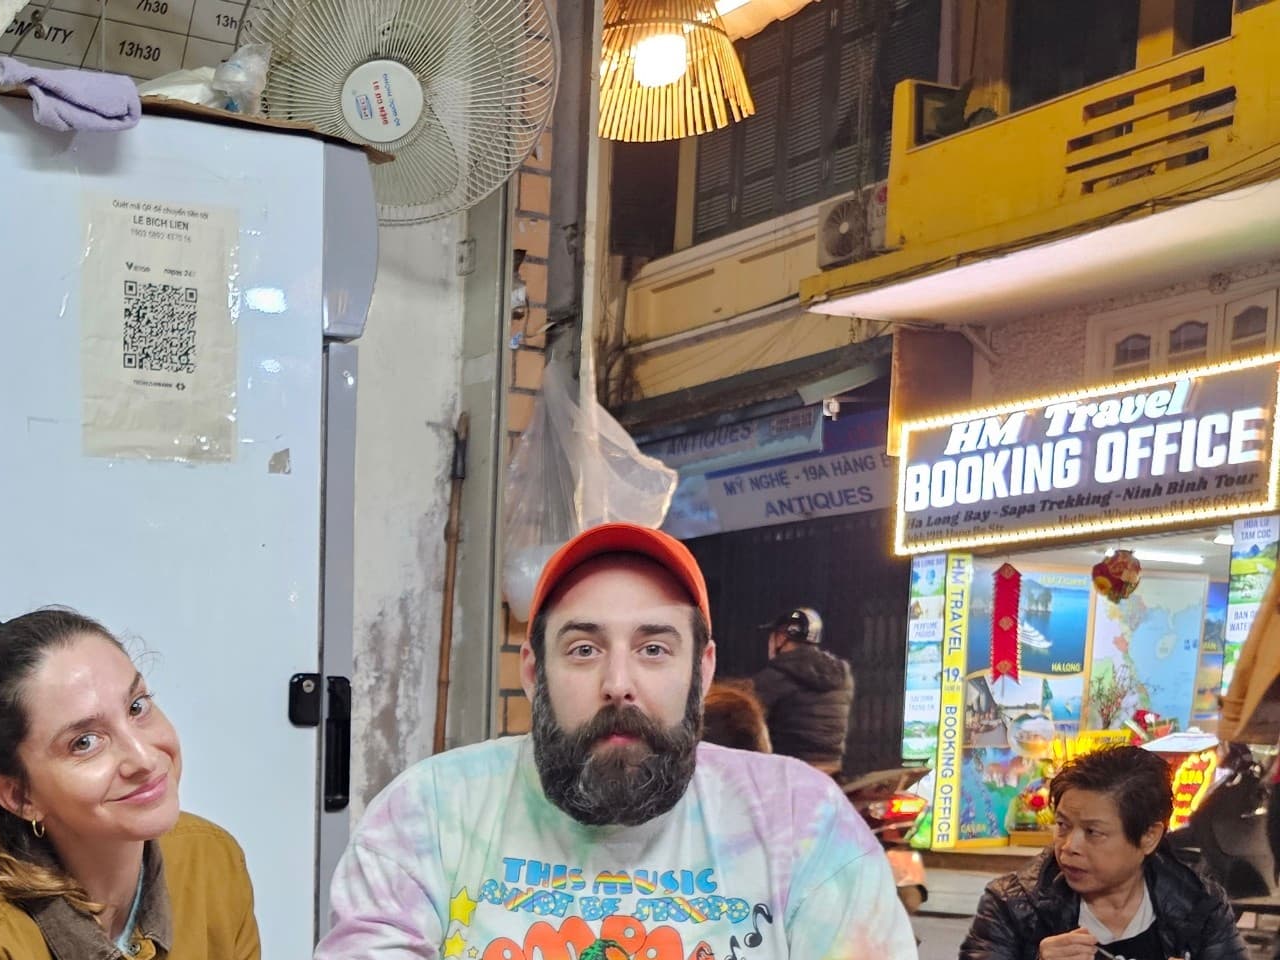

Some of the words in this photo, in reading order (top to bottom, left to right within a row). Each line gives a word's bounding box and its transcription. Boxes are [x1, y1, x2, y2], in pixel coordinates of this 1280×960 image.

[118, 40, 161, 62] 13h30
[133, 215, 144, 225] LE
[145, 216, 168, 228] BICH
[169, 219, 189, 231] LIEN
[944, 411, 1026, 456] HM
[1044, 378, 1191, 437] Travel
[801, 466, 829, 482] 19A
[831, 455, 876, 477] HÀNG
[904, 438, 1082, 512] BOOKING
[1095, 407, 1262, 483] OFFICE
[765, 486, 874, 518] ANTIQUES
[926, 512, 960, 528] Long
[963, 508, 992, 523] Bay
[1000, 503, 1036, 518] Sapa
[1039, 490, 1113, 512] Trekking
[1122, 482, 1163, 501] Ninh
[1166, 477, 1208, 496] Binh
[1213, 473, 1260, 489] Tour
[951, 558, 965, 584] HM
[948, 589, 964, 655] TRAVEL
[941, 706, 958, 779] BOOKING
[937, 784, 953, 843] OFFICE
[503, 857, 586, 891] THIS
[592, 868, 718, 896] MUSIC
[579, 896, 623, 922] BE
